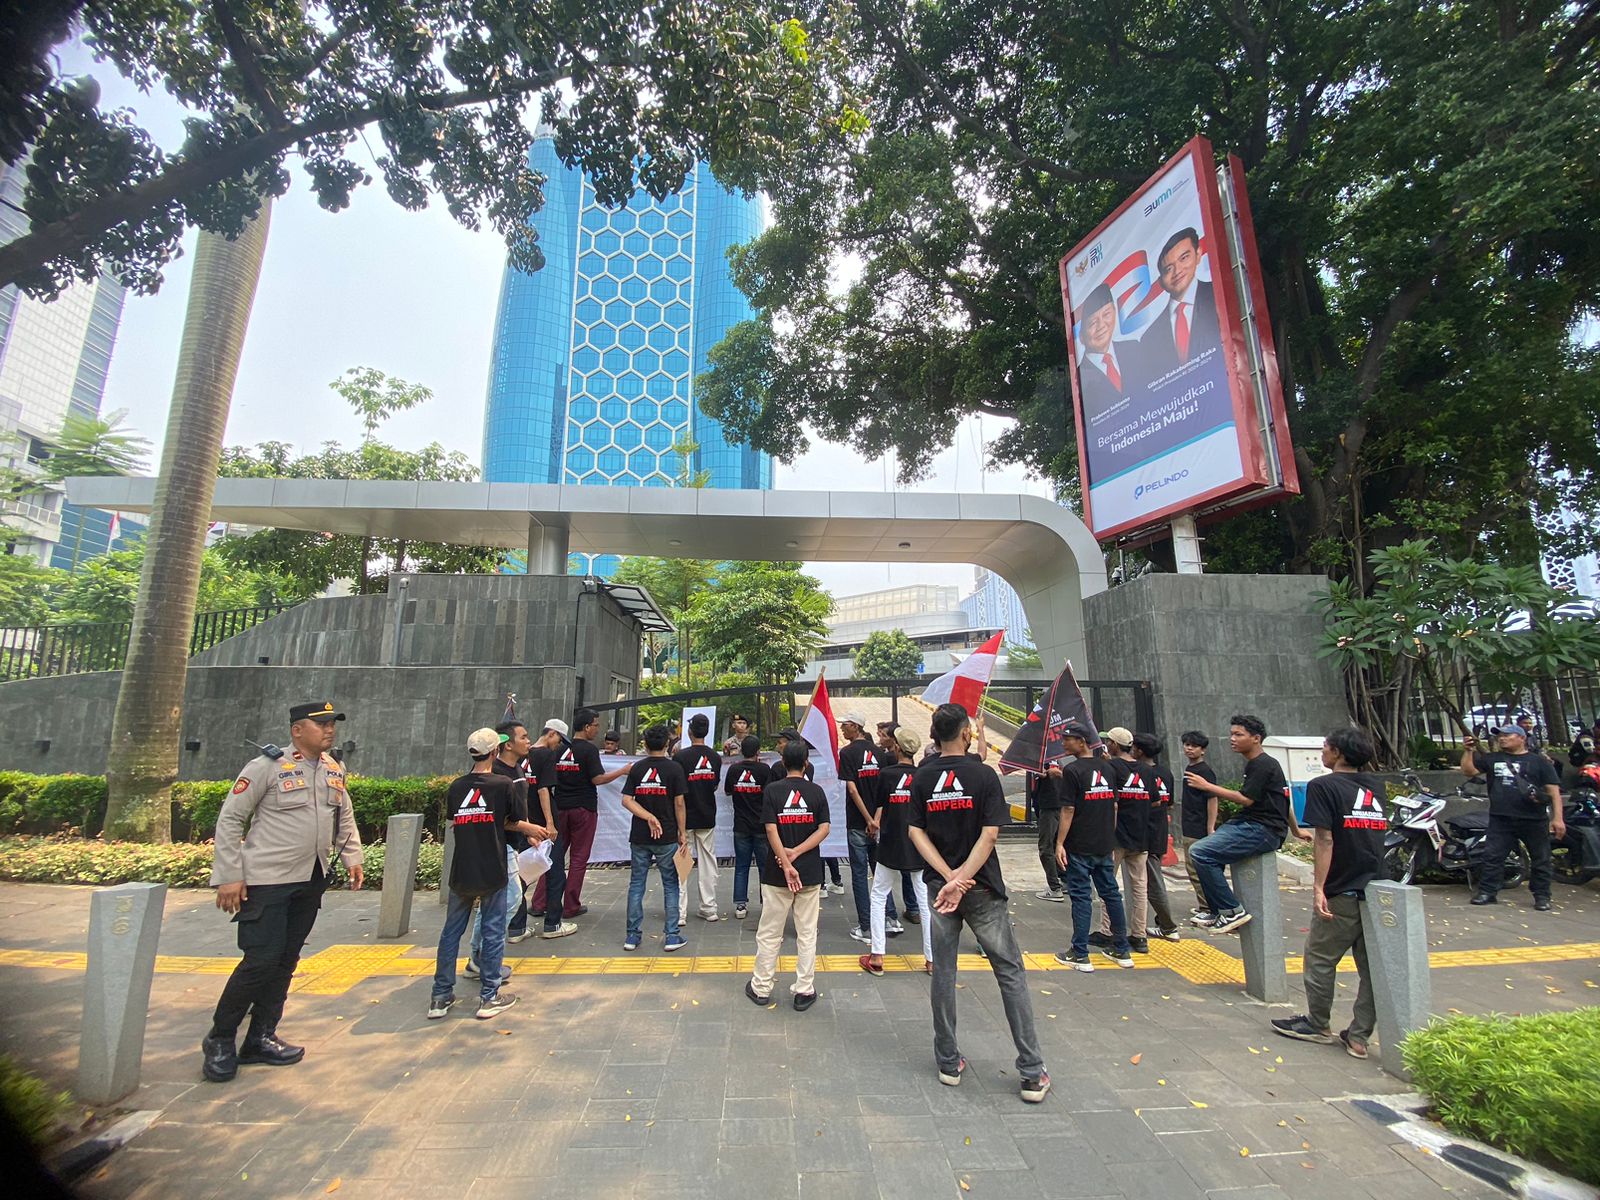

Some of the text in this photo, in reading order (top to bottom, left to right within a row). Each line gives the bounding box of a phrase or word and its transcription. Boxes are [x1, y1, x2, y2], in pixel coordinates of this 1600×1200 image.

[1200, 347, 1217, 360] Raka
[1097, 380, 1215, 449] Bersama Mewujudkan
[1111, 400, 1199, 454] Indonesia Maju!
[1145, 469, 1189, 493] PELINDO
[687, 773, 716, 781] AMPERA
[634, 788, 667, 796] AMPERA
[733, 786, 763, 794] AMPERA
[1084, 792, 1114, 800] AMPERA
[1117, 792, 1150, 800] AMPERA
[926, 799, 974, 812] AMPERA
[453, 814, 495, 826] AMPERA
[778, 814, 814, 824] AMPERA
